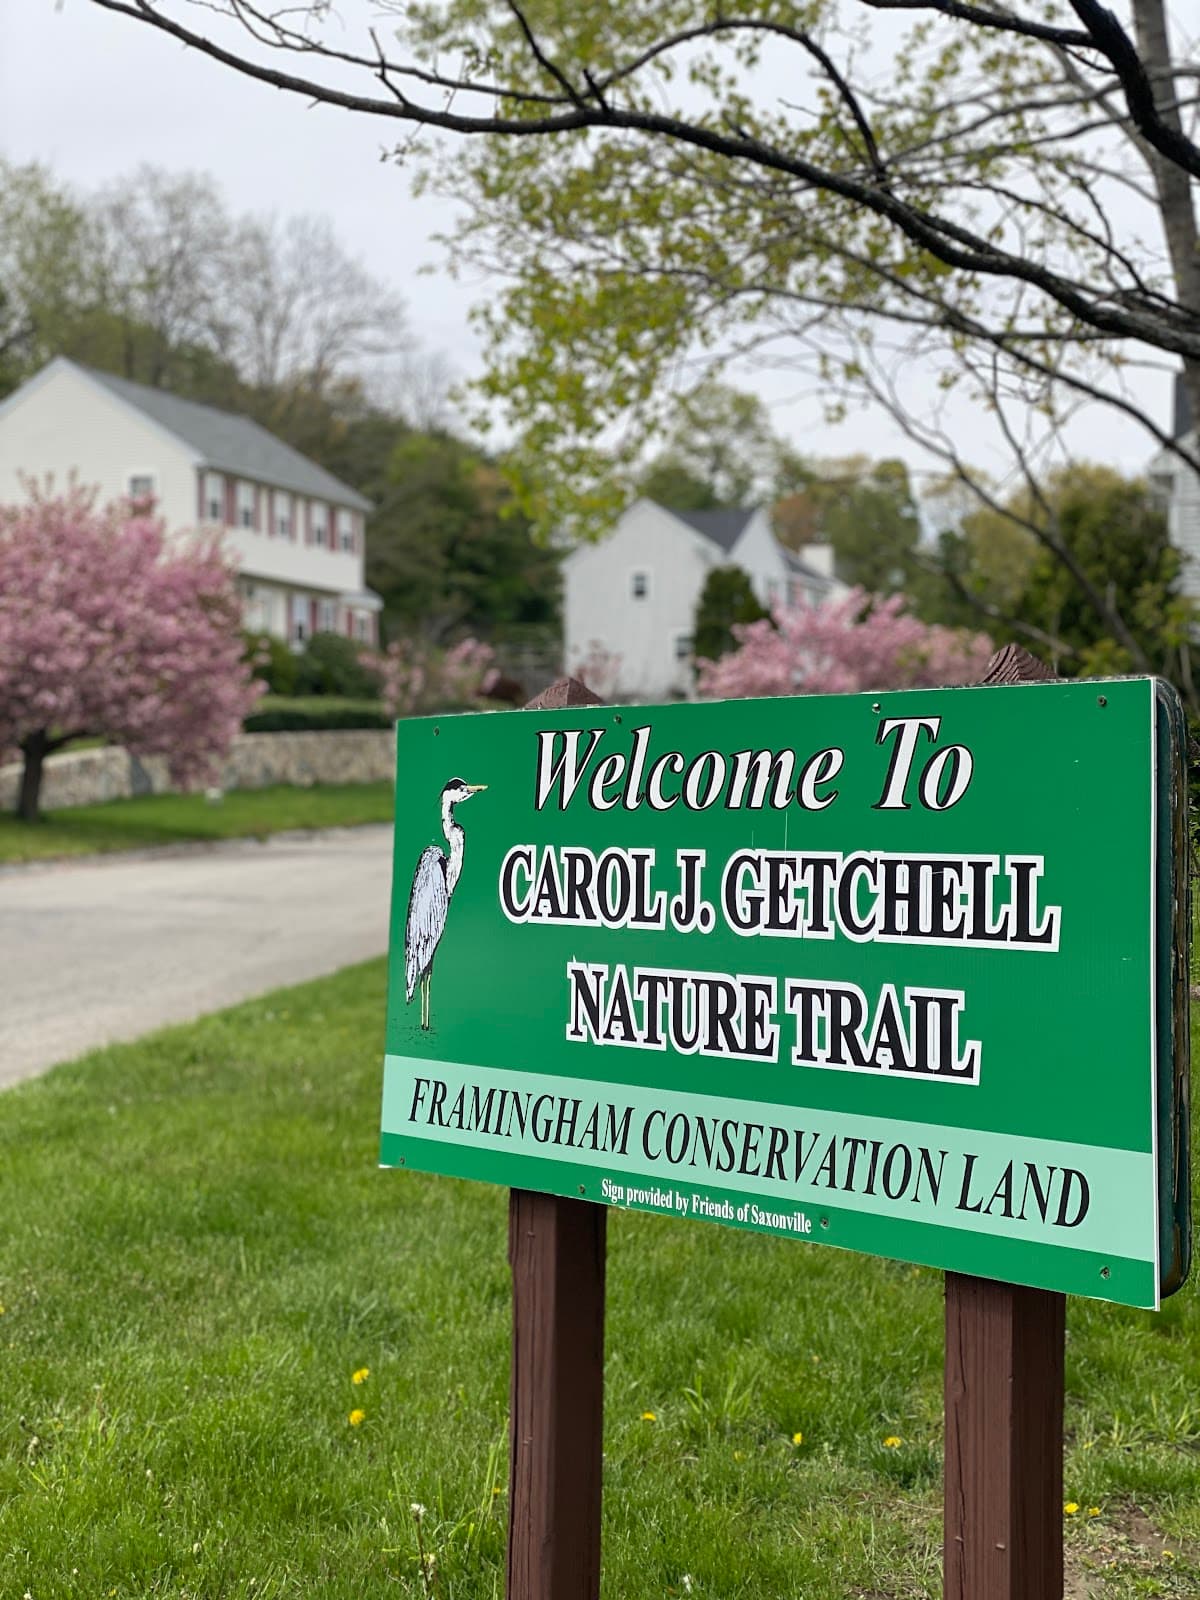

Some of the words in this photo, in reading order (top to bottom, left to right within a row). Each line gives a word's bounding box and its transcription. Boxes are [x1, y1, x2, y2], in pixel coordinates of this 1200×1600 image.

[534, 725, 844, 811] Welcome
[876, 716, 974, 811] To
[499, 844, 666, 930] CAROL
[670, 847, 717, 934] J.
[721, 847, 1062, 952] GETCHELL
[566, 961, 778, 1063] NATURE
[785, 977, 982, 1085] TRAIL
[407, 1077, 635, 1155] FRAMINGHAM
[642, 1109, 950, 1206] CONSERVATION
[956, 1153, 1090, 1229] LAND
[601, 1178, 624, 1203] Sign
[626, 1186, 673, 1208] provided
[675, 1193, 689, 1216] by
[692, 1194, 734, 1220] Friends
[737, 1203, 750, 1223] of
[751, 1204, 812, 1234] Saxonville
